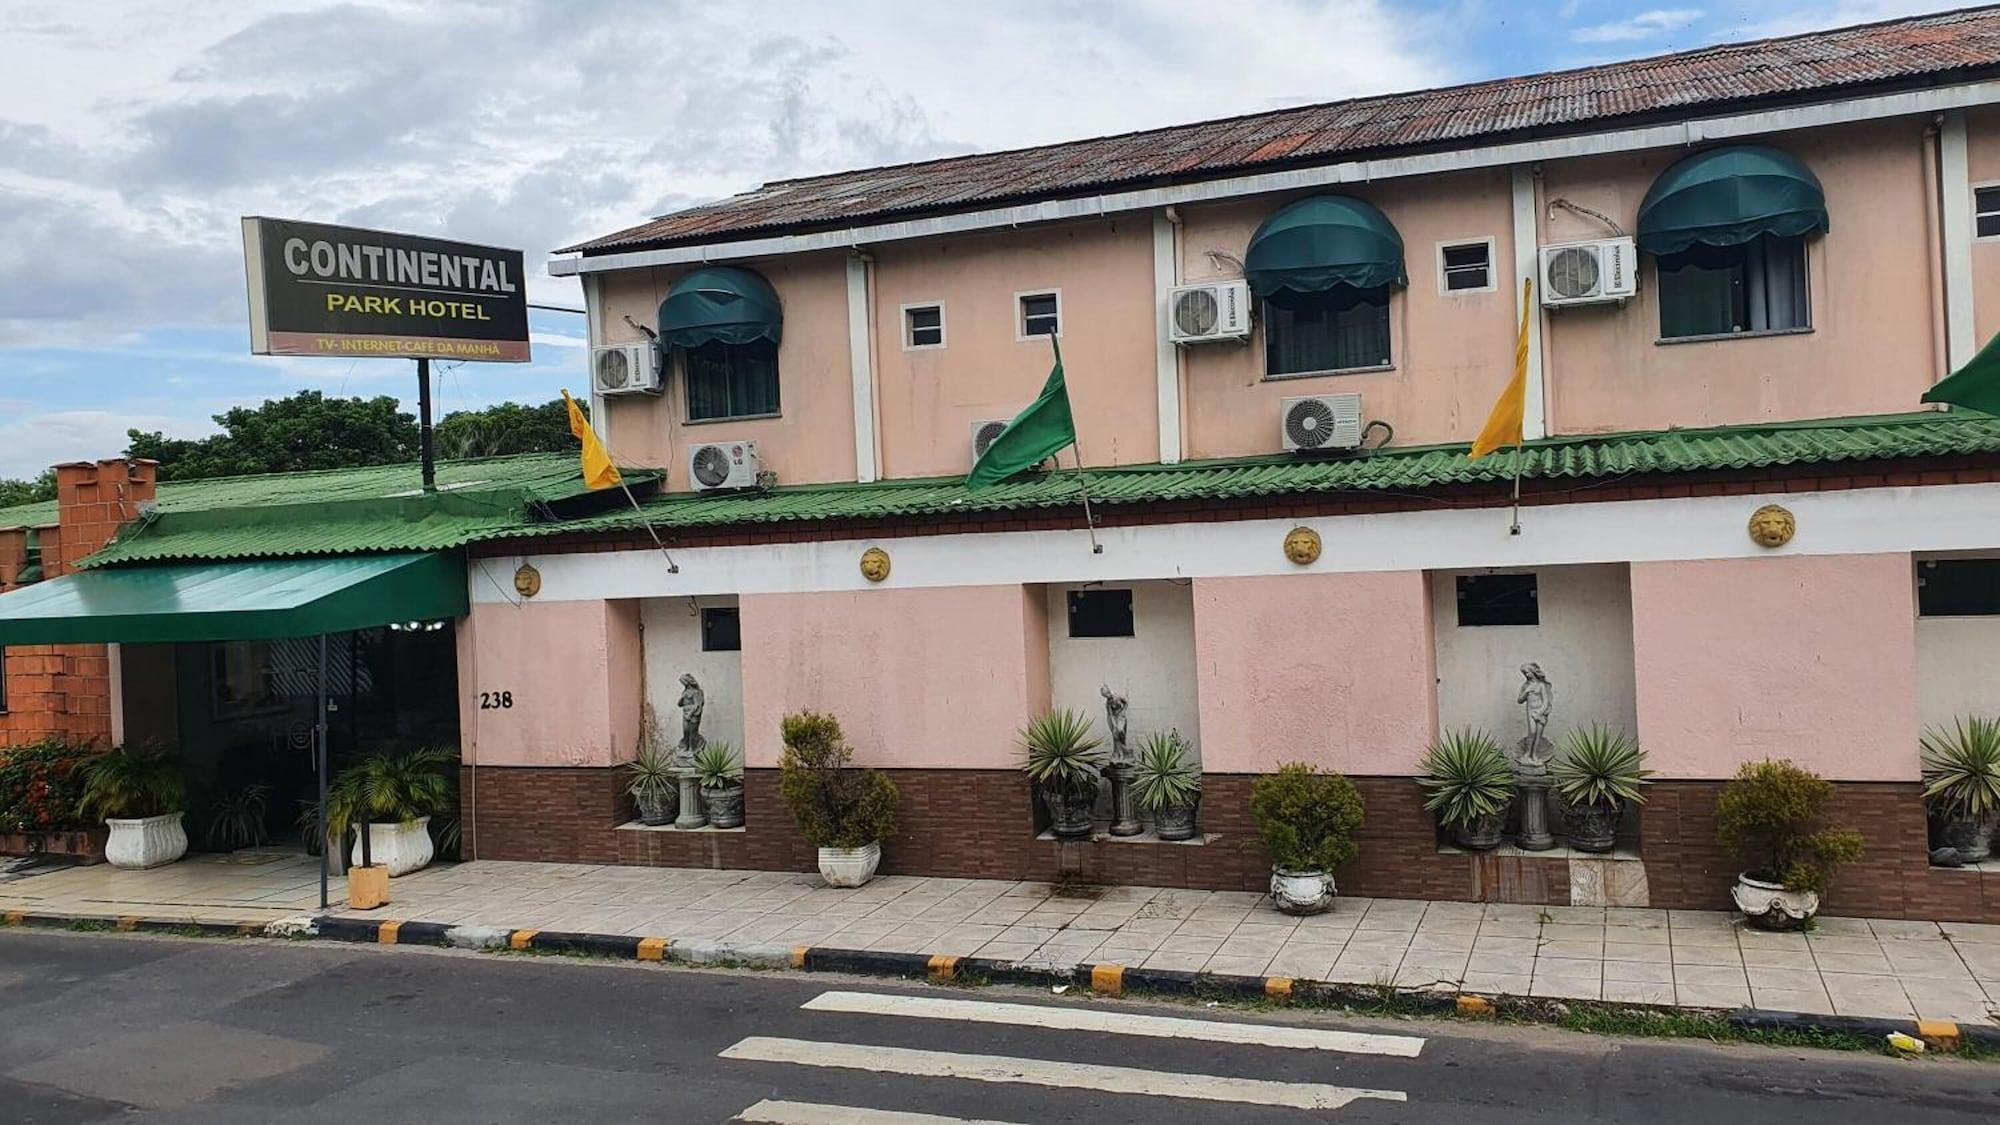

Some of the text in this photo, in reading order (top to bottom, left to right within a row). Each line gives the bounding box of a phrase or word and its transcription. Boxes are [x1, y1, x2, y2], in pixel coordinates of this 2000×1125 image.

[284, 237, 515, 292] CONTINENTAL
[327, 294, 491, 320] PARK HOTEL
[438, 343, 454, 354] DA
[733, 458, 743, 466] LG
[480, 690, 513, 710] 238
